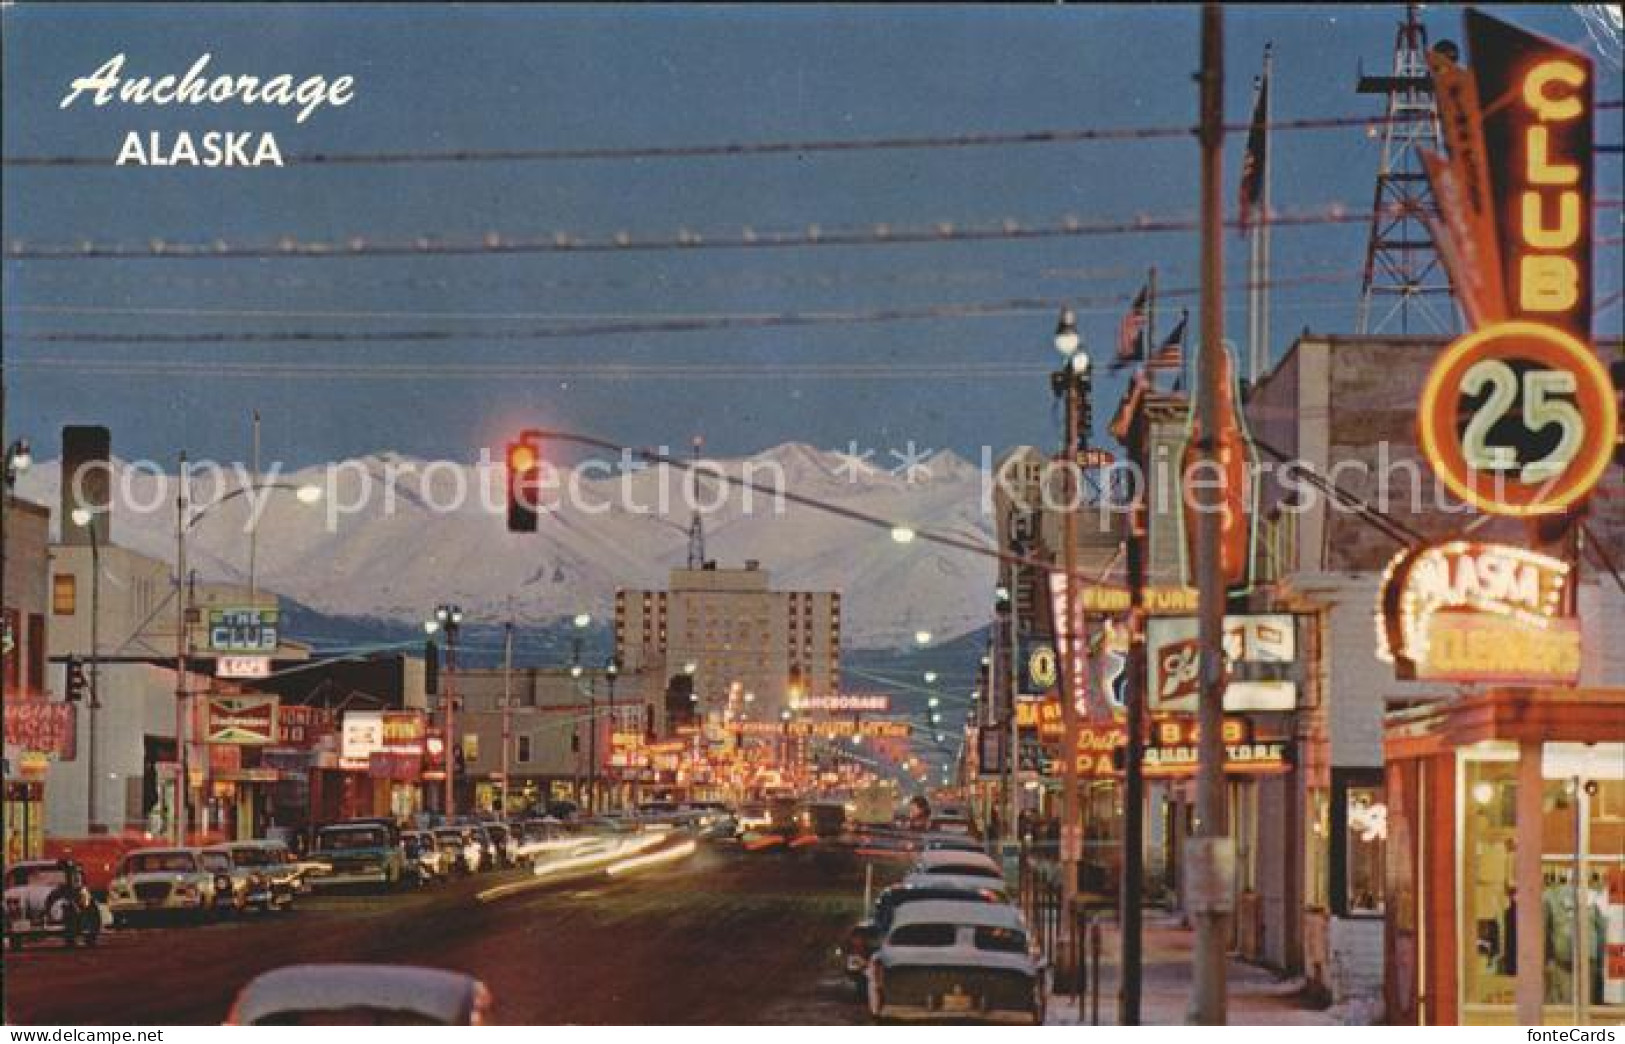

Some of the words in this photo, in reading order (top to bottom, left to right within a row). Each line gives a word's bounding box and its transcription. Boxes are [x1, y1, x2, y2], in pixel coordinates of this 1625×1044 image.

[1519, 58, 1587, 313] CLUB
[1459, 358, 1586, 486] 25
[212, 628, 277, 650] CLUB
[221, 608, 260, 625] THE
